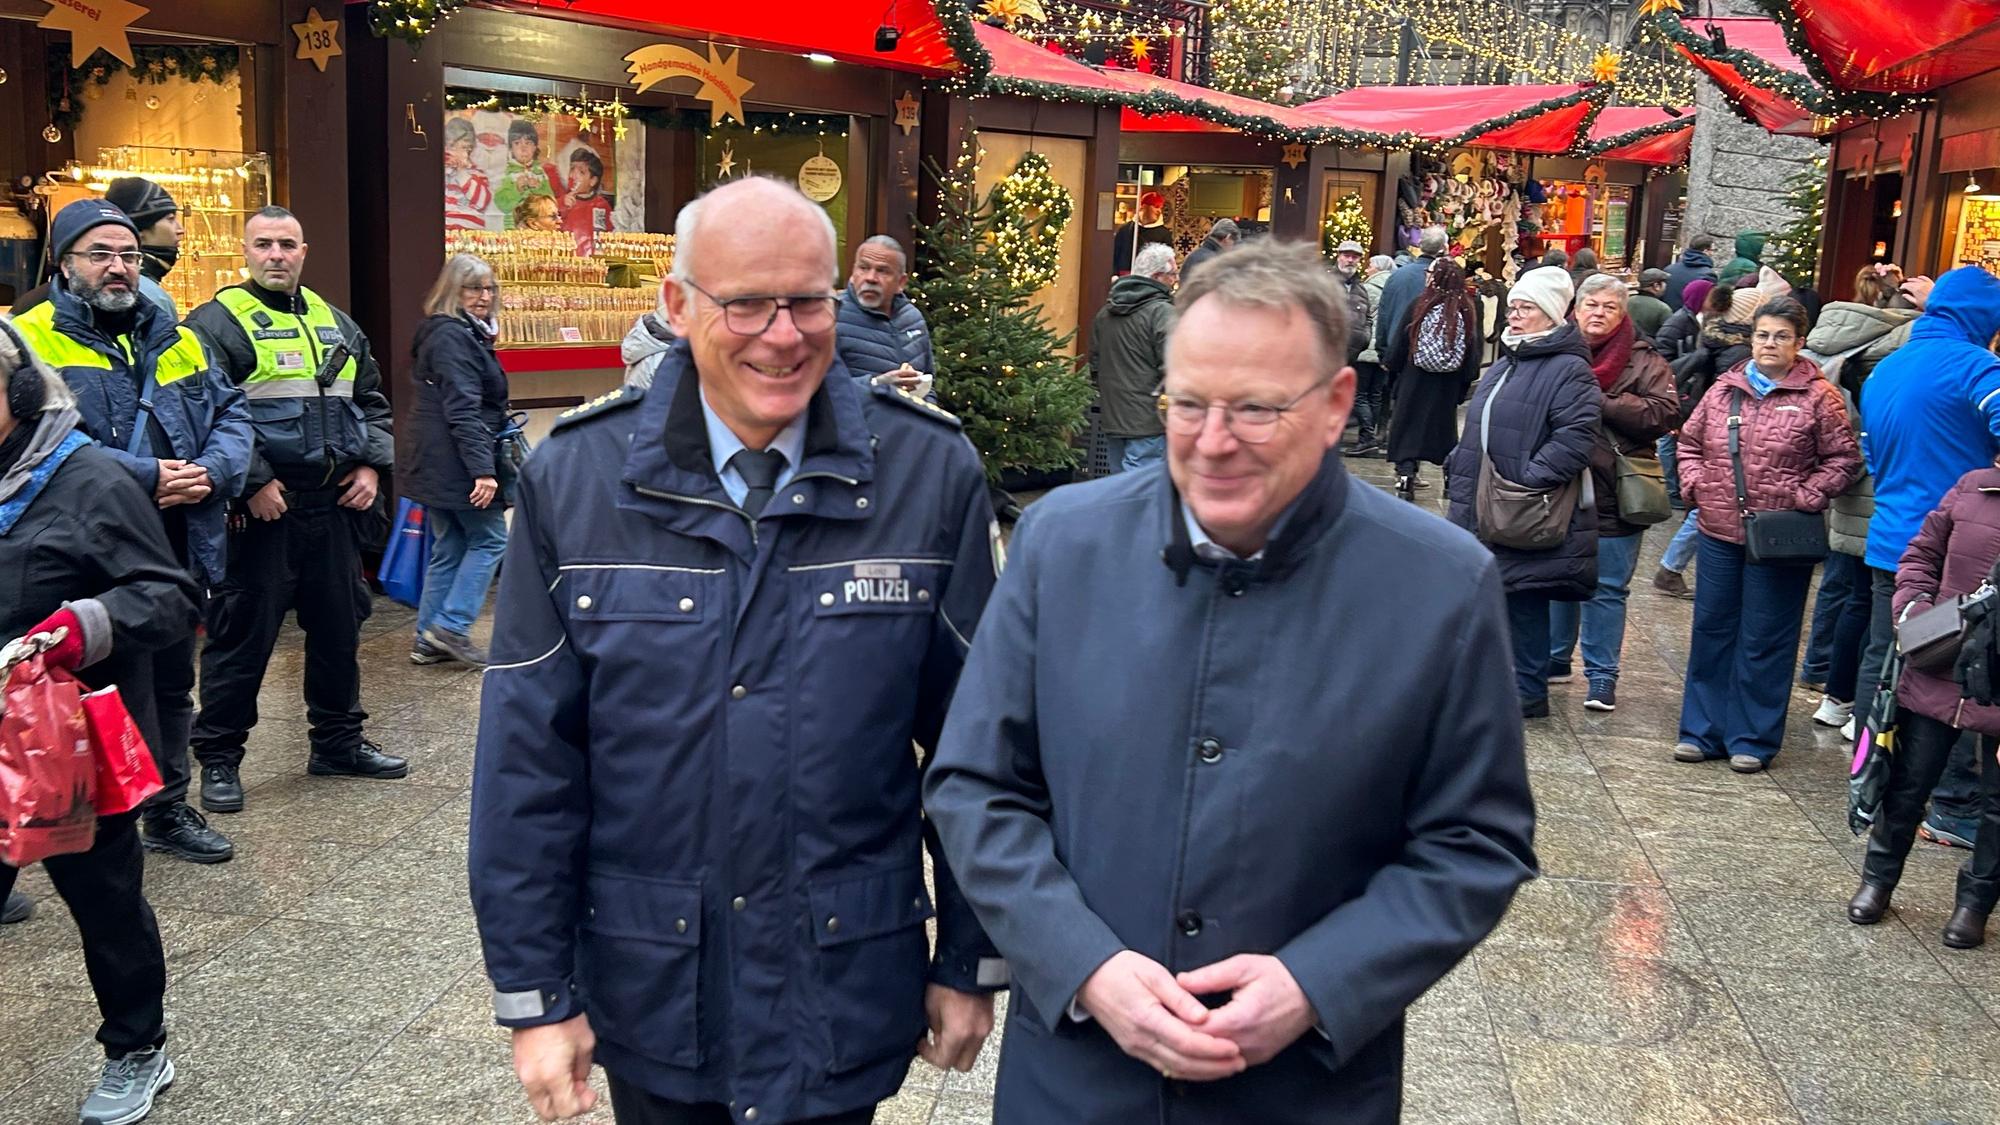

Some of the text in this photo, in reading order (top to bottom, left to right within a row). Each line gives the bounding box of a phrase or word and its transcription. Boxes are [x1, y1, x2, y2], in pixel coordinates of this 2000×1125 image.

[304, 30, 331, 51] 138
[640, 58, 702, 75] Handgemachte
[902, 106, 915, 120] 139
[258, 330, 294, 338] Service
[843, 579, 910, 604] POLIZEI
